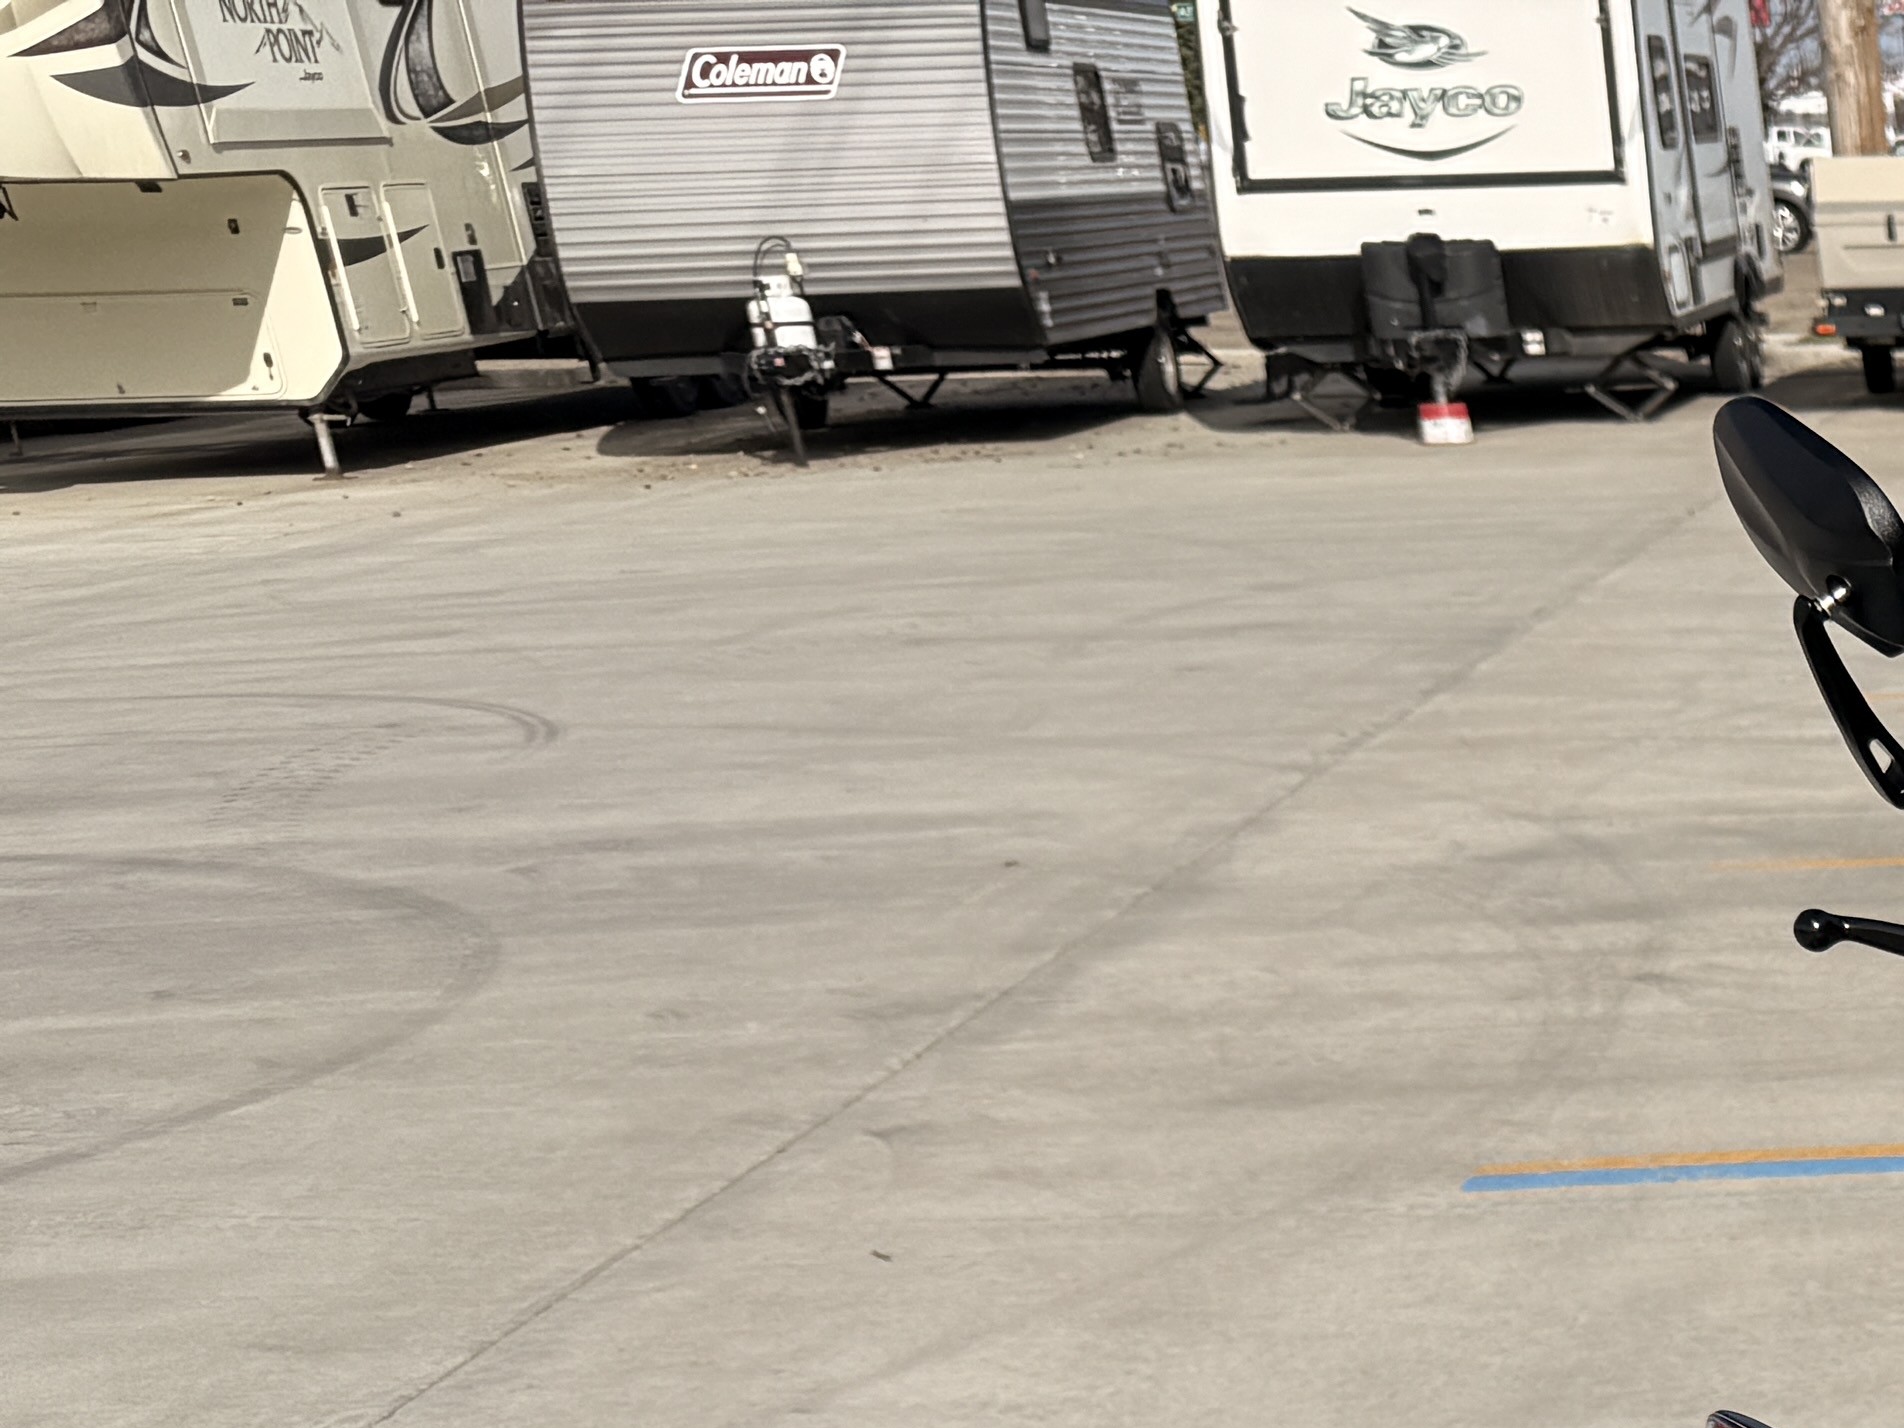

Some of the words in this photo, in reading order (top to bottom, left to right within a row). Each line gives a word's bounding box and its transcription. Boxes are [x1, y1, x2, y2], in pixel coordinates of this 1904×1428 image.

[264, 28, 319, 63] POINT
[691, 53, 809, 88] Coleman
[1324, 77, 1525, 129] Jayco
